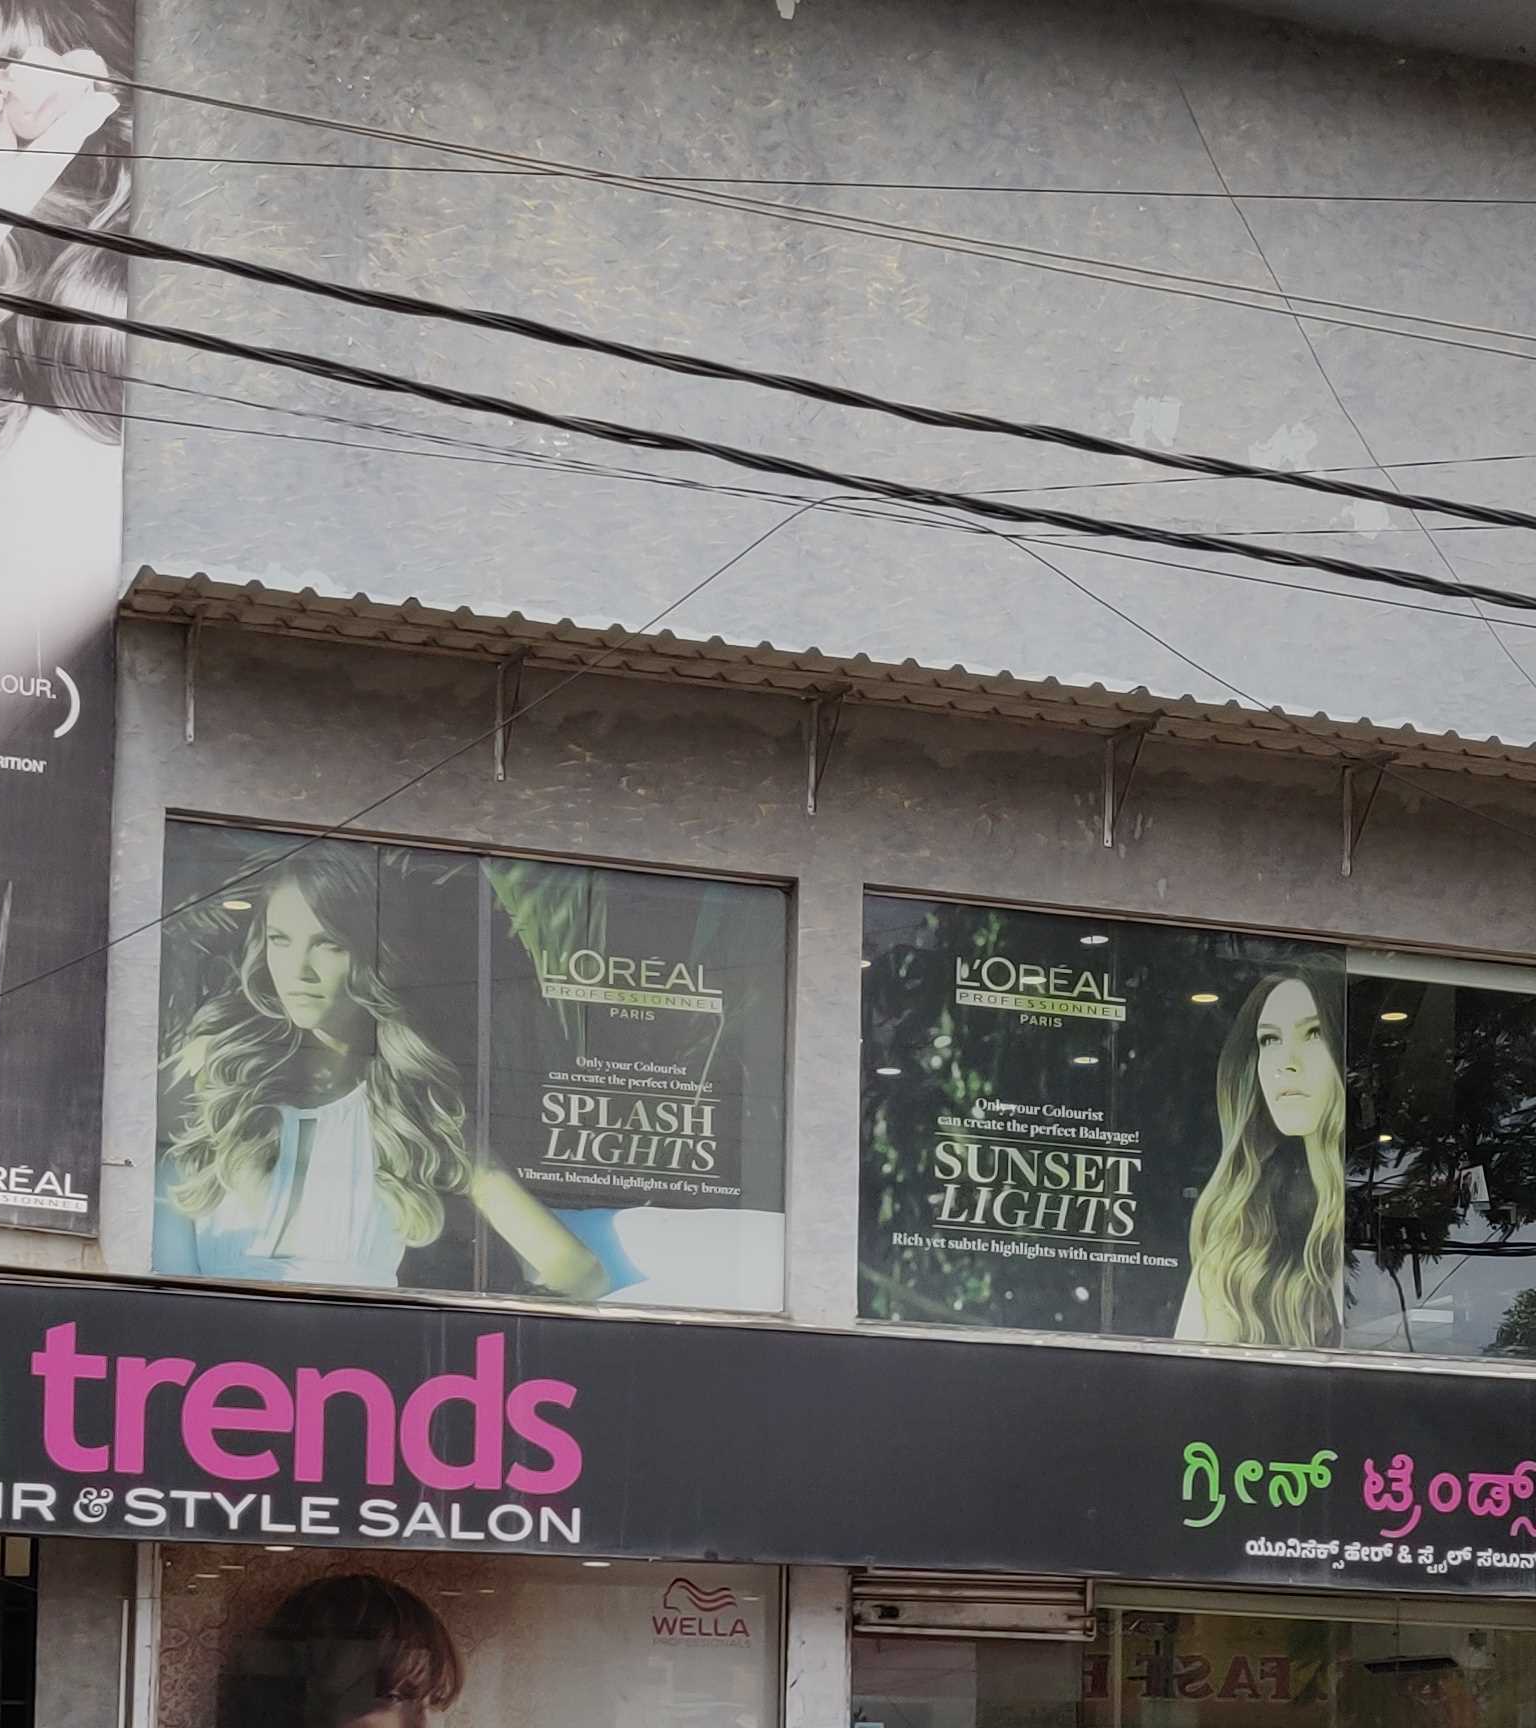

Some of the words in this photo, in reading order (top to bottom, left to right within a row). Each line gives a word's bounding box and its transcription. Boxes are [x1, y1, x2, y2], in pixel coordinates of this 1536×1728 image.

[545, 985, 721, 1011] PROFESSIONNEL
[959, 992, 1123, 1018] PROFESSIONNEL
[609, 1007, 655, 1022] PARIS
[1020, 1014, 1063, 1028] PARIS
[575, 1056, 602, 1070] Only
[605, 1060, 631, 1073] your
[633, 1061, 687, 1076] Colourist
[548, 1072, 569, 1081] can
[571, 1072, 606, 1084] create
[607, 1074, 627, 1085] the
[628, 1077, 668, 1090] perfect
[541, 1092, 716, 1137] SPLASH
[976, 1097, 1008, 1116] Only
[1042, 1103, 1104, 1121] Colourist
[937, 1116, 961, 1127] can
[964, 1117, 1005, 1131] create
[1007, 1119, 1028, 1133] the
[1030, 1122, 1076, 1139] perfect
[1079, 1126, 1140, 1145] Balayage!
[542, 1128, 717, 1172] LIGHTS
[516, 1167, 563, 1182] Vibrant,
[565, 1171, 611, 1185] blended
[612, 1175, 668, 1191] highlights
[669, 1180, 683, 1191] of
[683, 1182, 699, 1196] icy
[702, 1184, 741, 1196] bronze
[934, 1140, 1142, 1196] SUNSET
[936, 1183, 1137, 1238] LIGHTS
[892, 1232, 923, 1247] Rich
[924, 1236, 947, 1251] yet
[948, 1237, 989, 1253] subtle
[991, 1240, 1056, 1261] highlights
[1058, 1246, 1088, 1261] with
[1090, 1249, 1142, 1266] caramel
[1143, 1254, 1178, 1268] tones
[29, 1320, 584, 1497] trends
[73, 1486, 114, 1524] &
[122, 1486, 341, 1537] STYLE
[356, 1496, 582, 1545] SALON
[652, 1616, 750, 1637] WELLA
